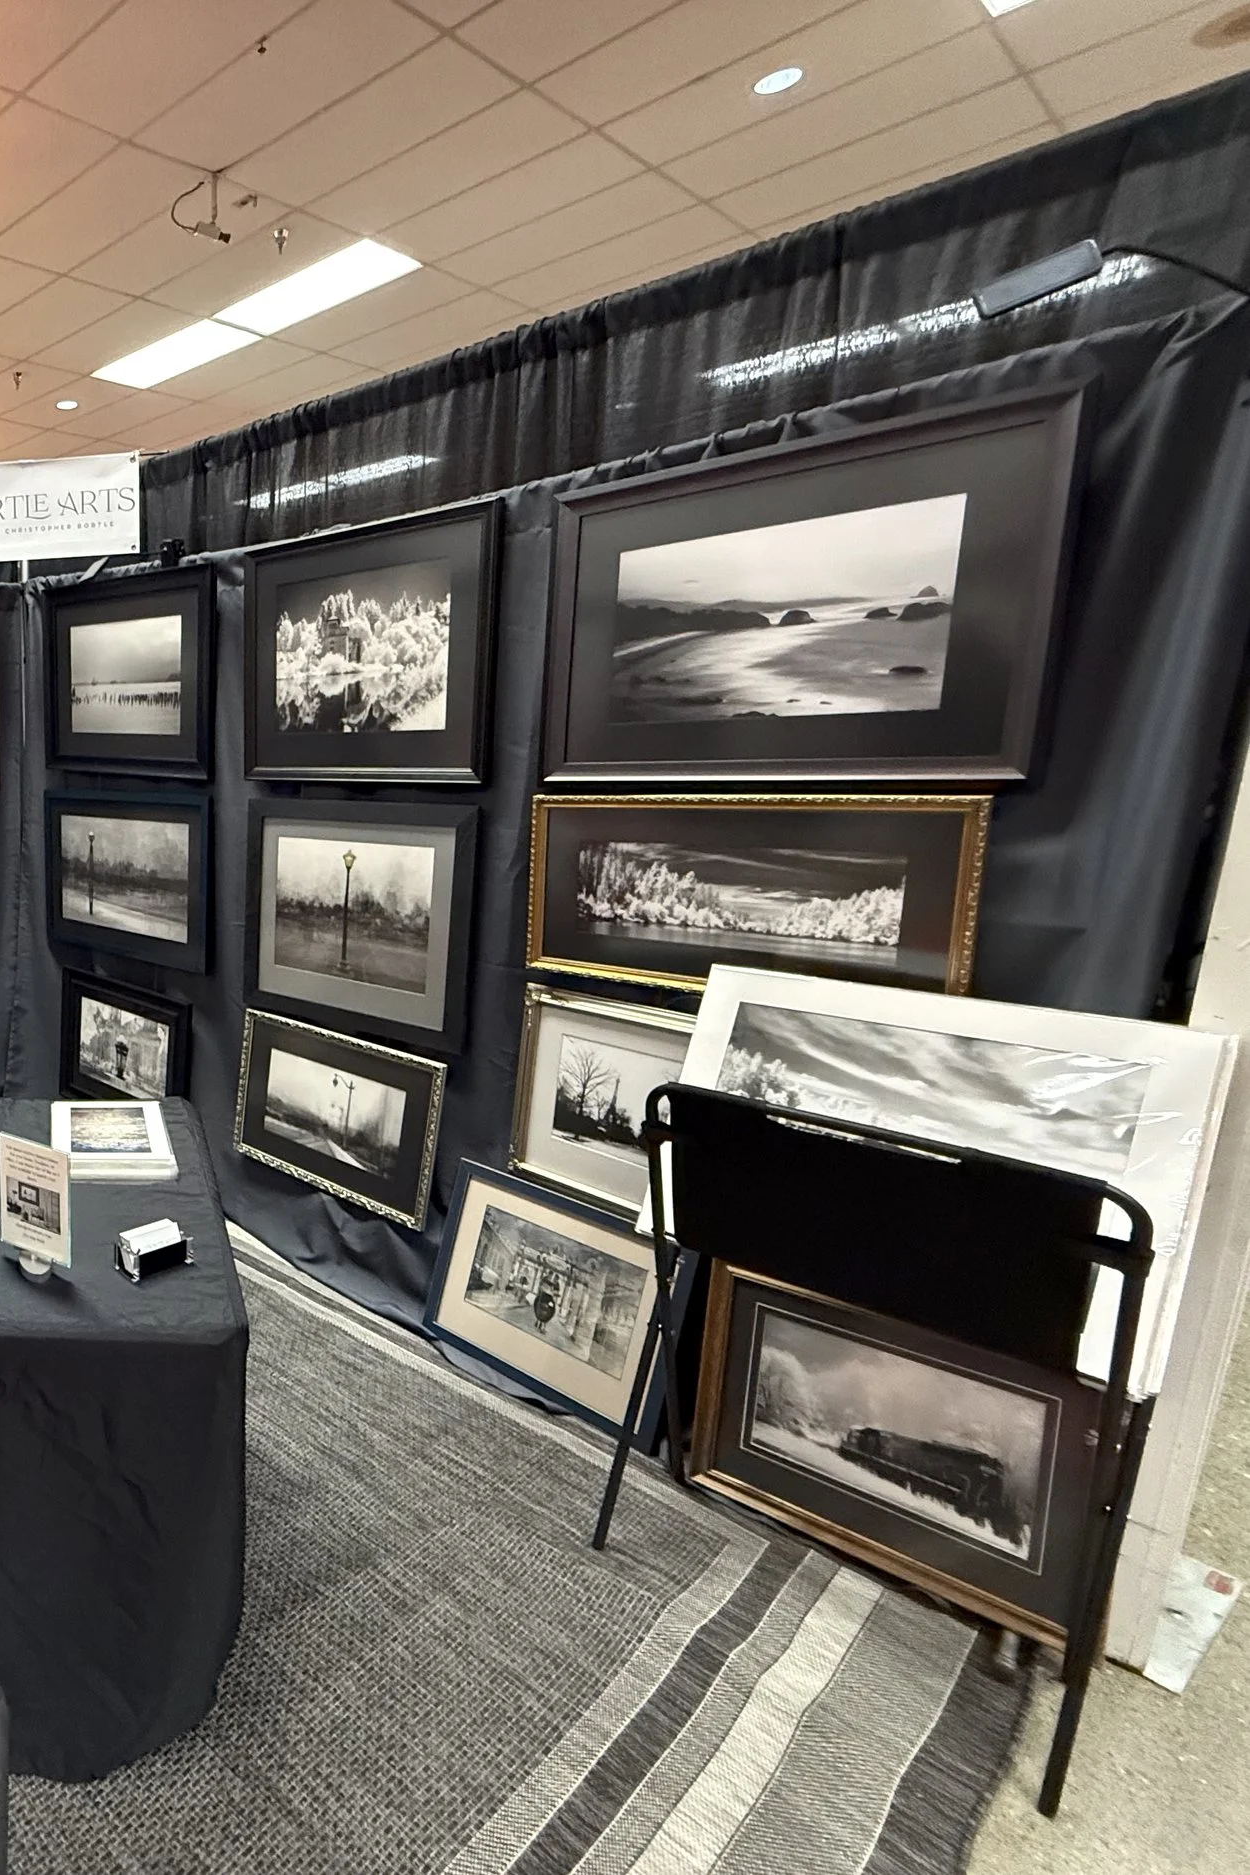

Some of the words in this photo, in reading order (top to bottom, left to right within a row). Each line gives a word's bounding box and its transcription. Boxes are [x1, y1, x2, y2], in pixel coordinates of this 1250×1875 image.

[57, 486, 136, 516] ARTS
[4, 524, 72, 535] CHRISTOPHER
[77, 521, 115, 529] BORTLE
